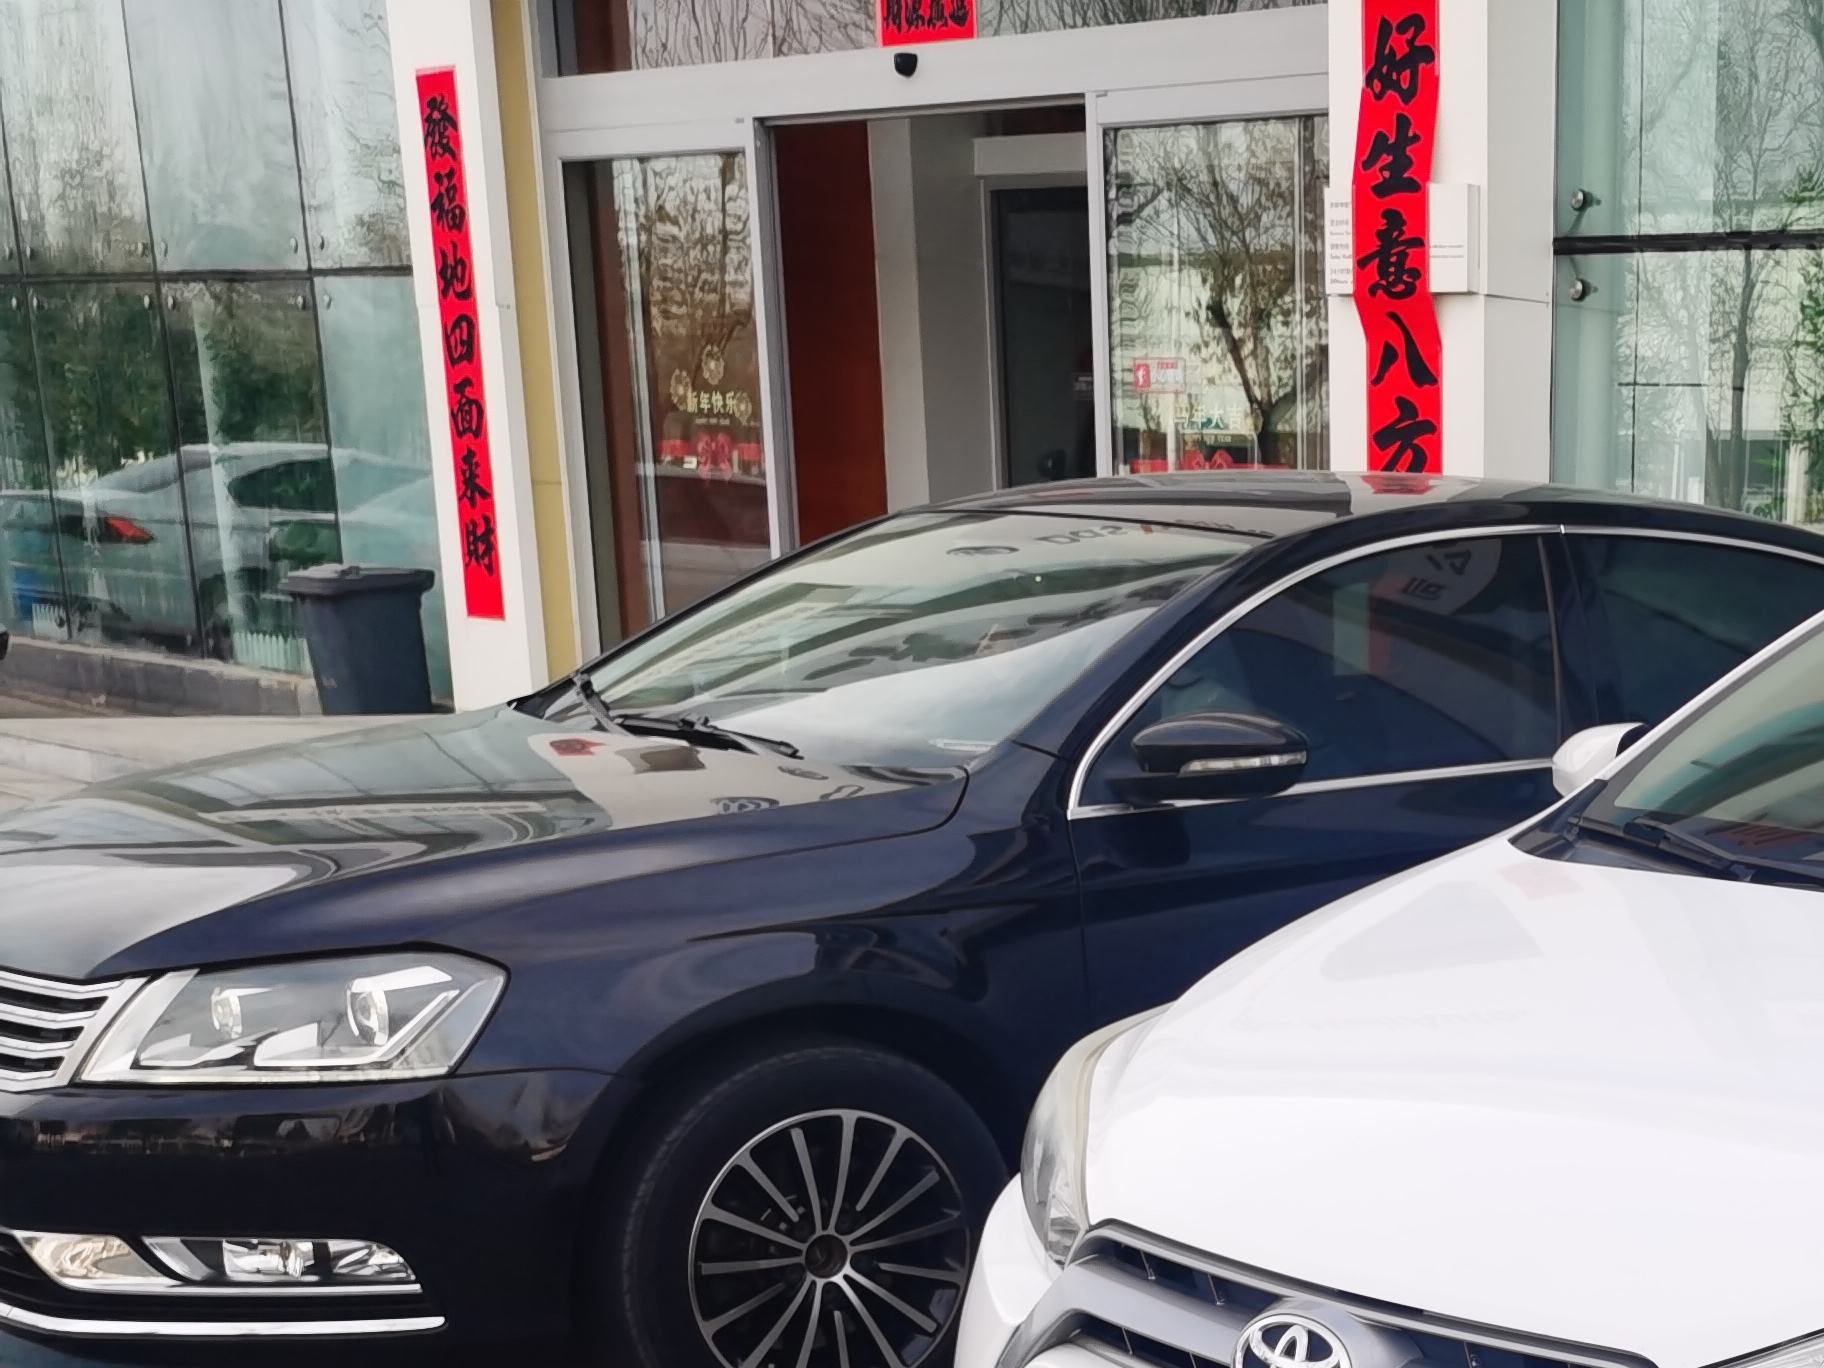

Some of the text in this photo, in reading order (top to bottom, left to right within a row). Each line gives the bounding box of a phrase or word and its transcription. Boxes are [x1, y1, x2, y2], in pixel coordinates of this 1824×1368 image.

[1356, 13, 1439, 473] 好生意八方
